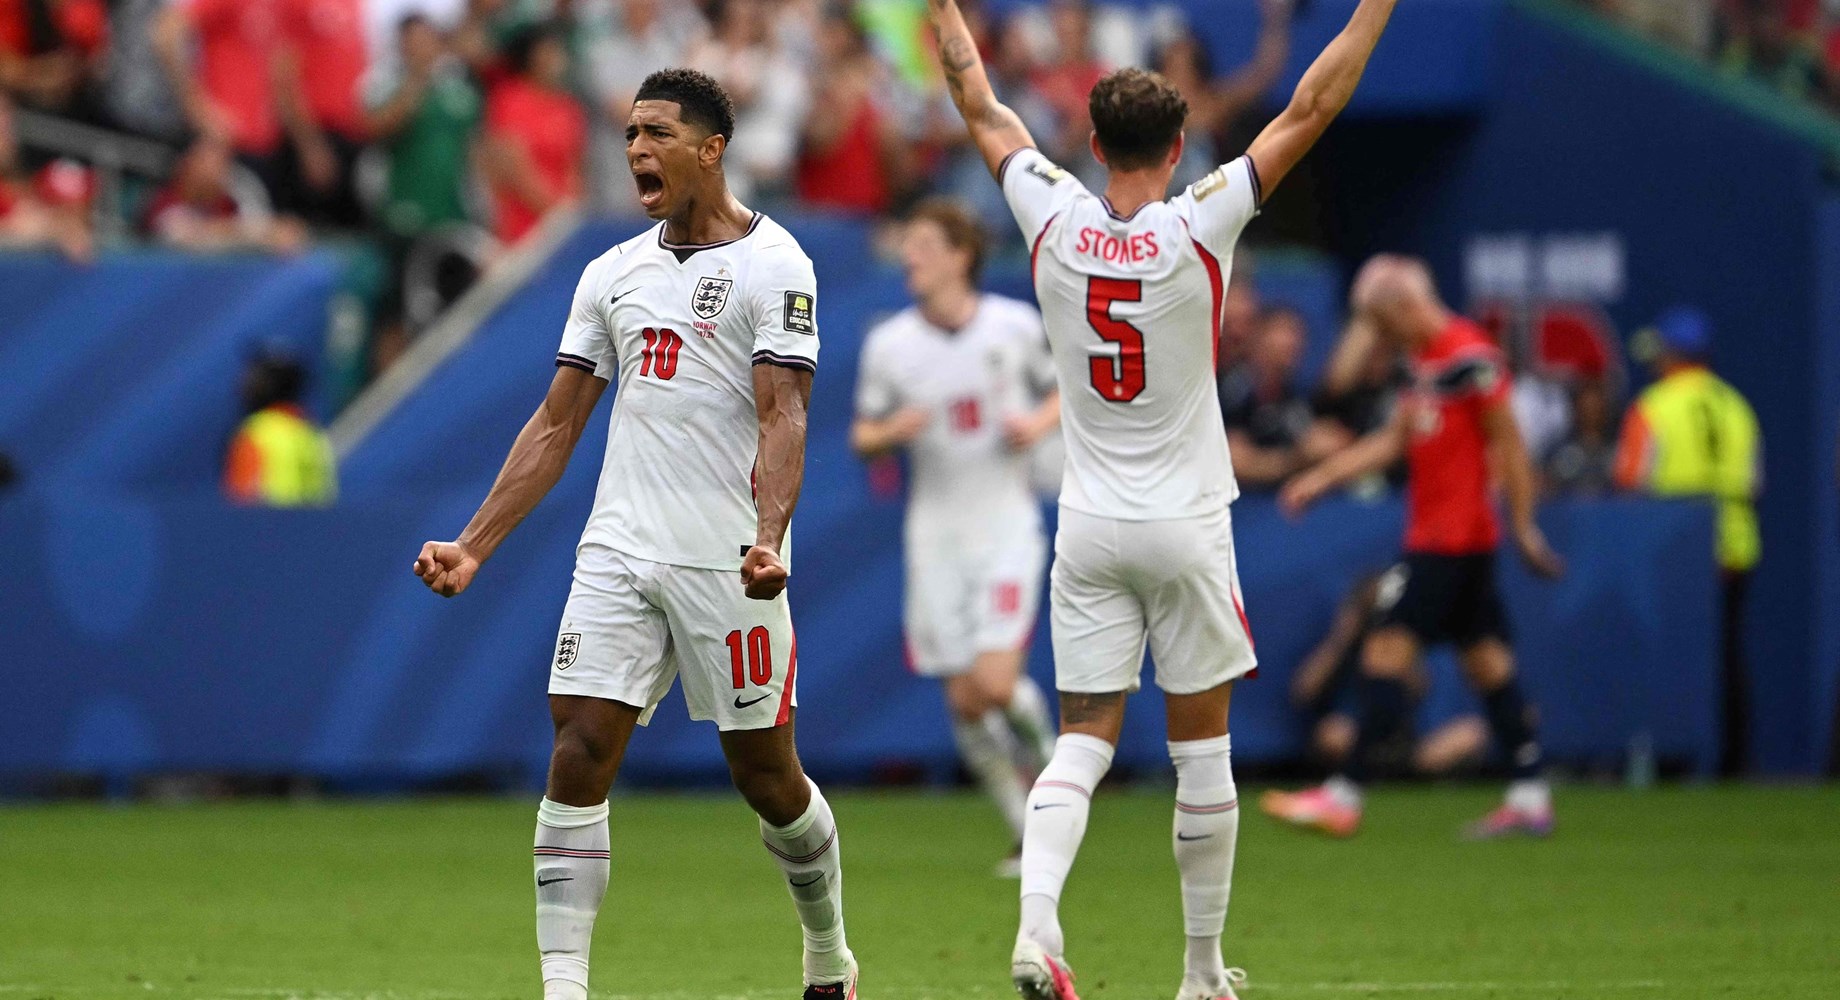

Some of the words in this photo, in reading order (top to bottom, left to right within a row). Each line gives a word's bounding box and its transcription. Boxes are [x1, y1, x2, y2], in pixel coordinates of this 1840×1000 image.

[1076, 227, 1160, 264] STONES
[639, 327, 683, 381] 10
[1086, 275, 1147, 403] 5
[726, 625, 773, 690] 10
